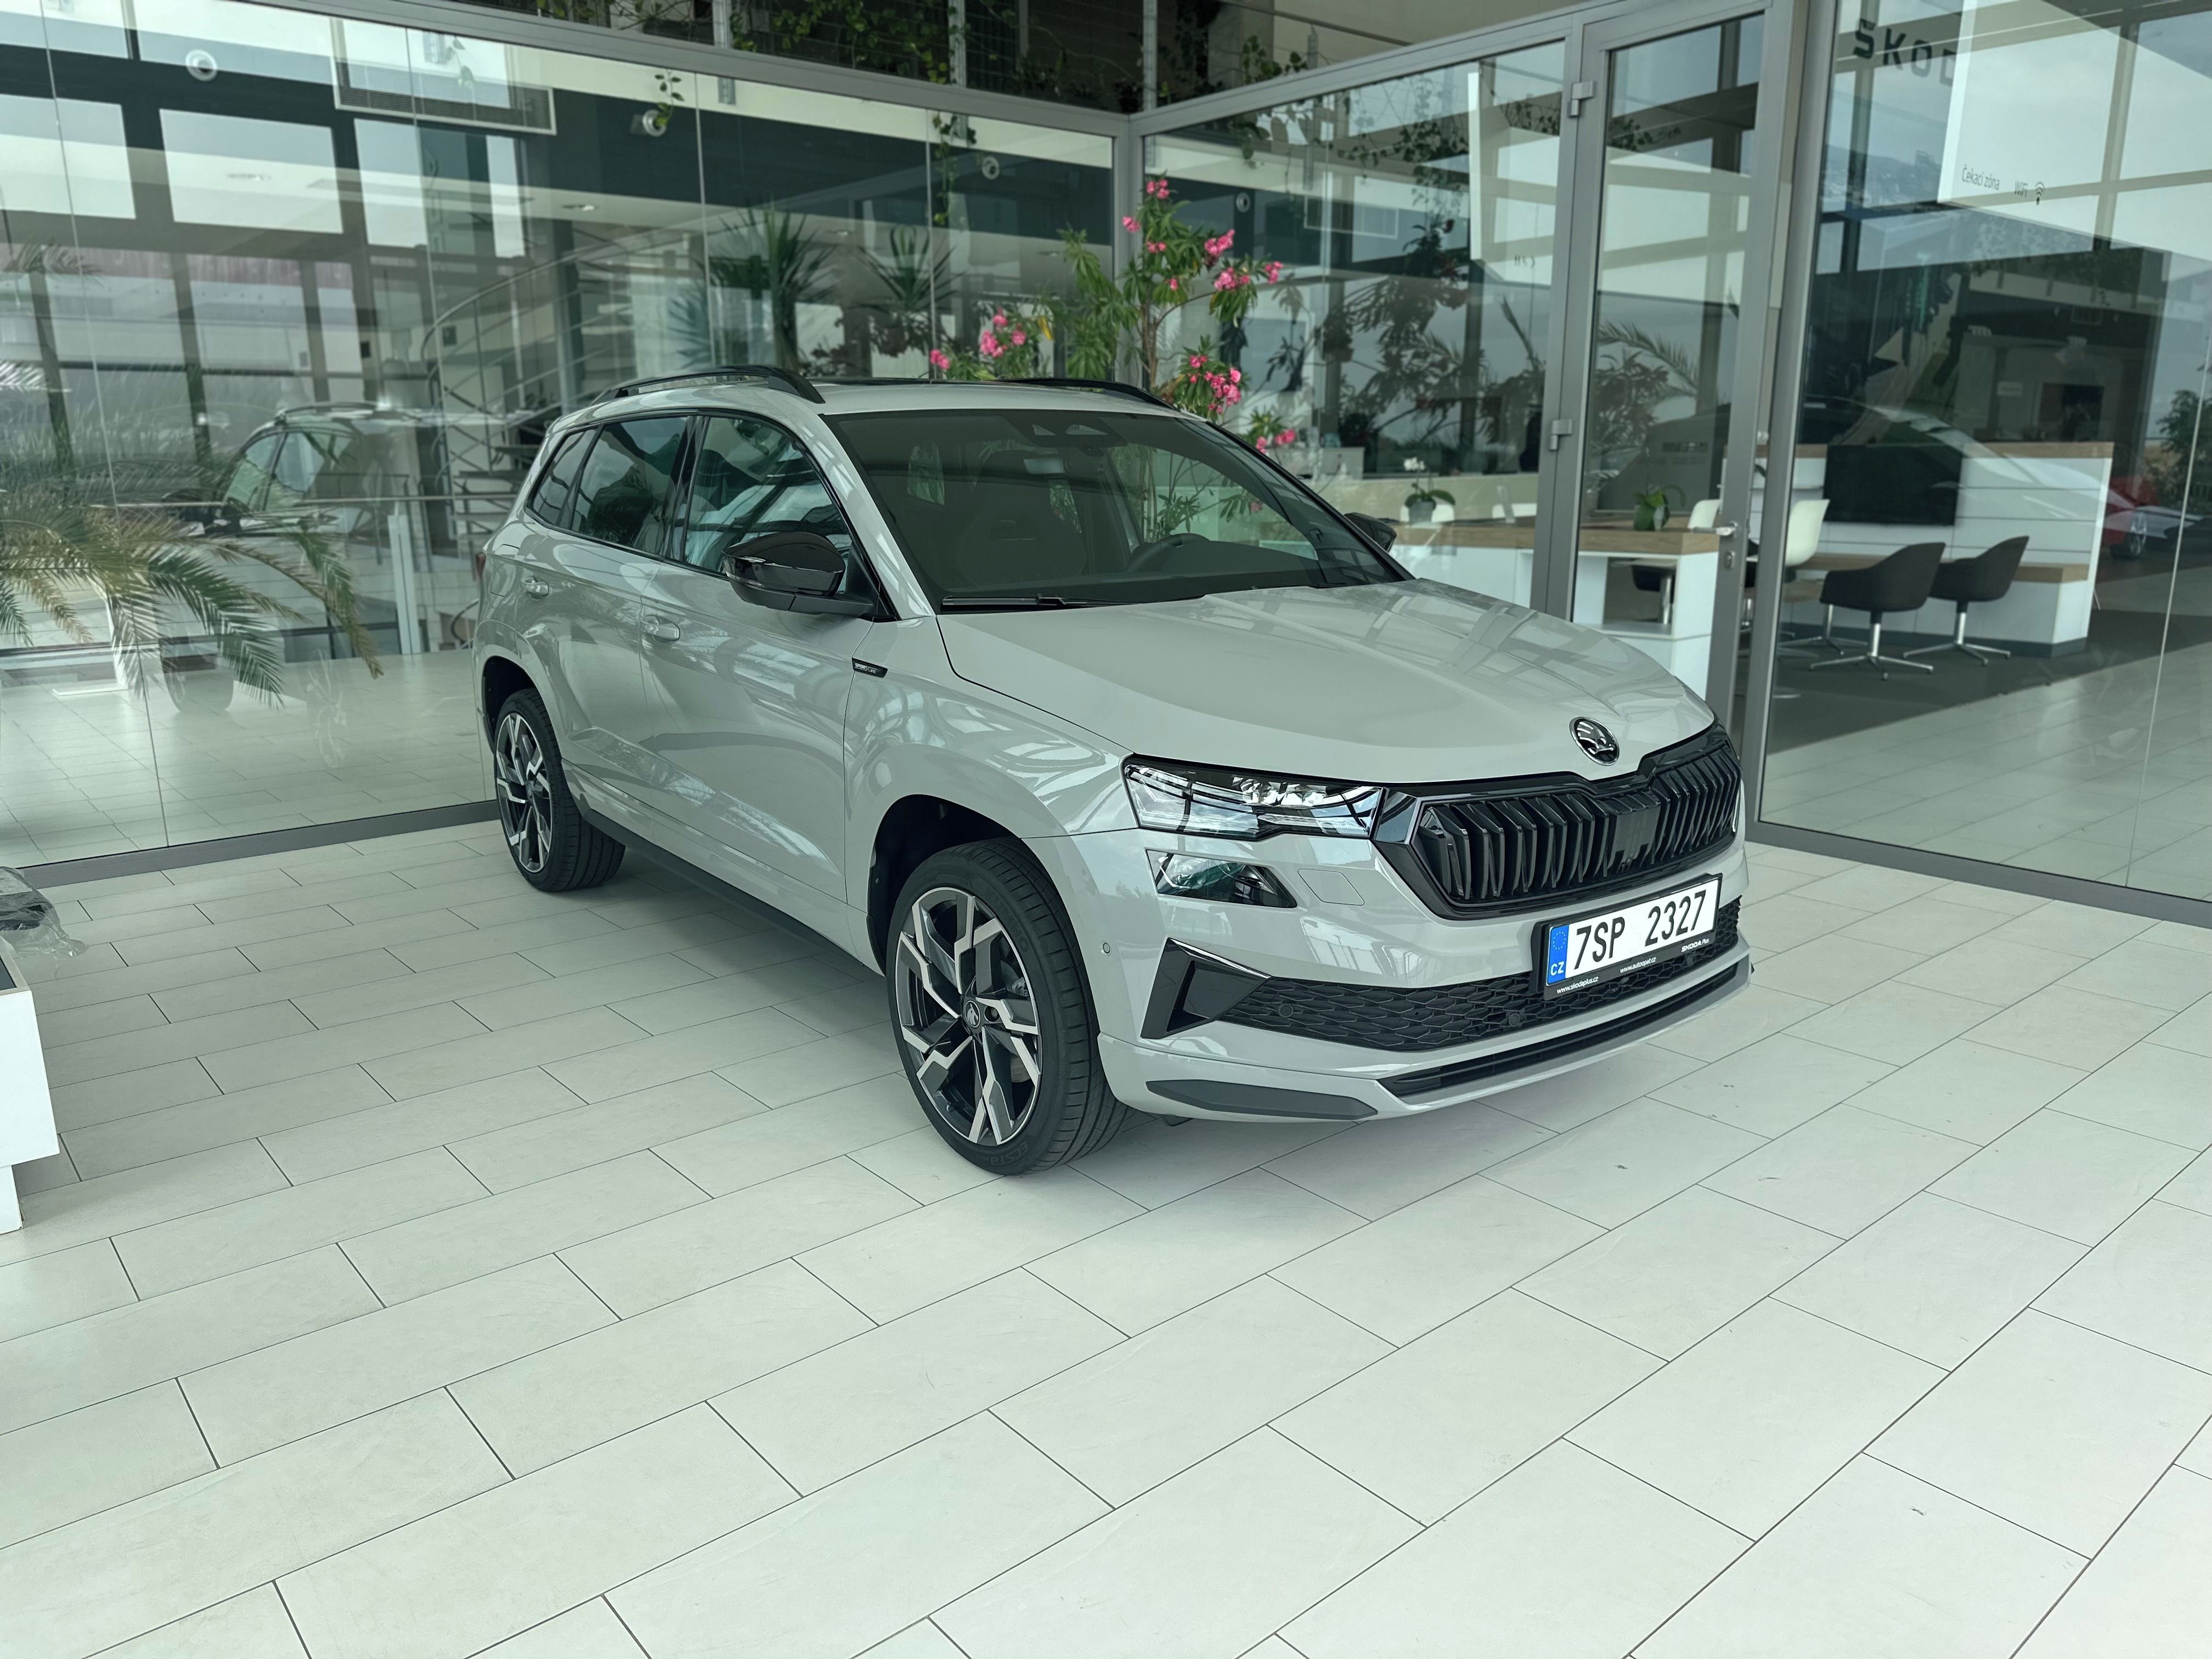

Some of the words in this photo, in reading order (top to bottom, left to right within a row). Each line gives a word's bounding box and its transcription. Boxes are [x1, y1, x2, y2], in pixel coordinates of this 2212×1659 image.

[1962, 164, 1984, 185] Čekací
[1984, 173, 2000, 190] zóna
[1573, 917, 1625, 970] 7SP
[1645, 889, 1706, 947] 2327
[1550, 961, 1564, 975] CZ
